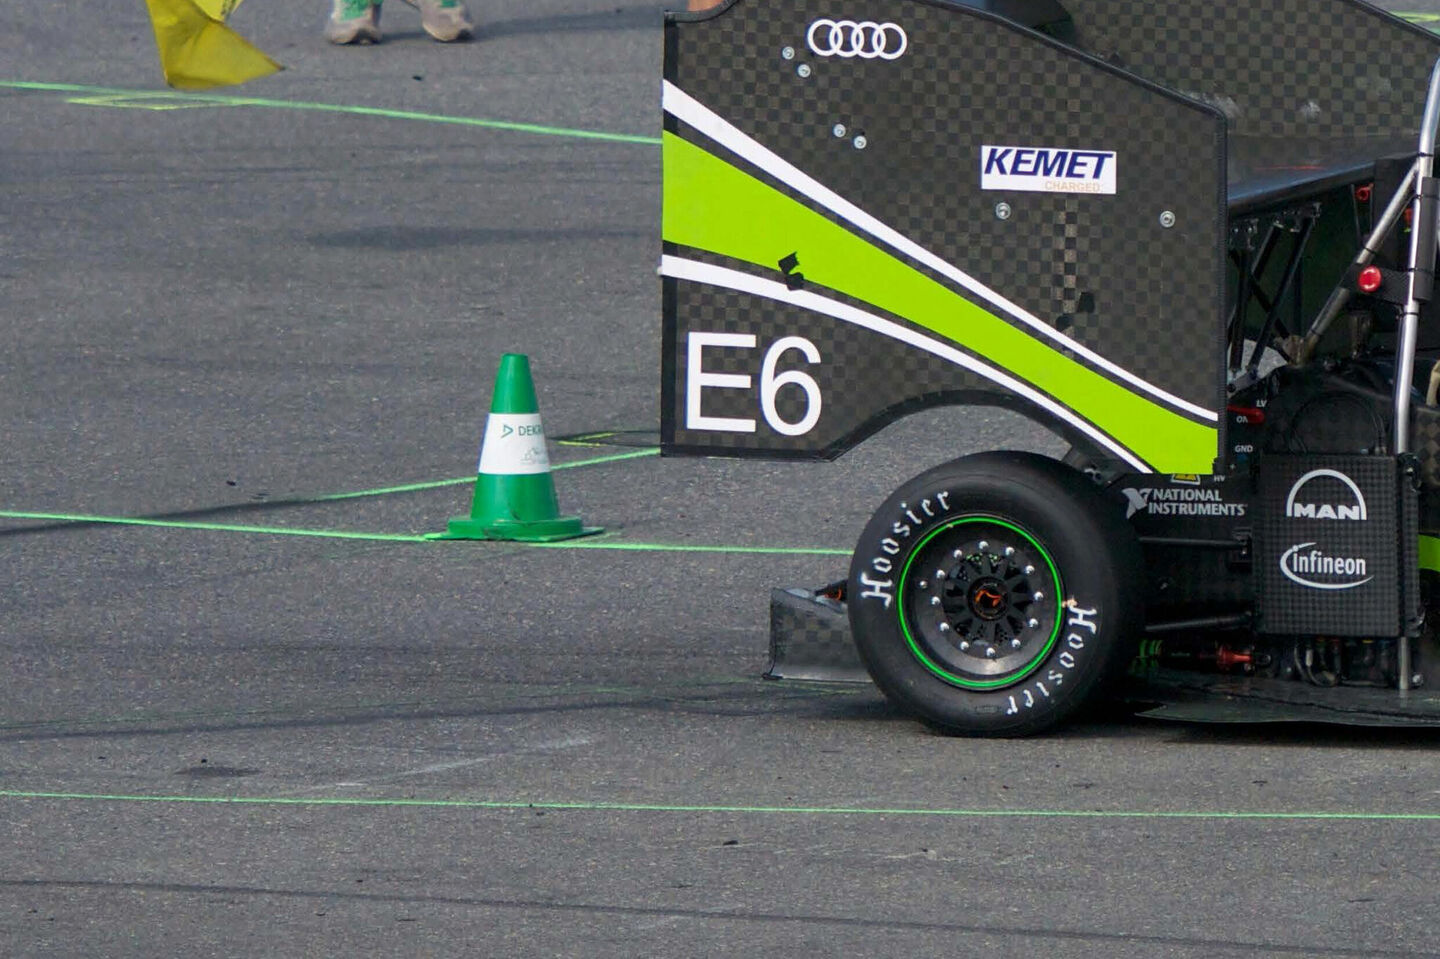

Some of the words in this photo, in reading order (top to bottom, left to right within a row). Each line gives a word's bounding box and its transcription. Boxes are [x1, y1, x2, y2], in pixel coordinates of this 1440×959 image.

[984, 148, 1113, 180] KEMET
[687, 331, 822, 436] E6
[1235, 445, 1253, 453] GND
[1153, 489, 1222, 502] NATIONAL
[1149, 502, 1245, 516] INSTRUMENTS
[1294, 503, 1360, 520] MAN
[860, 491, 950, 609] Hoosier
[1006, 604, 1098, 715] Hoosier
